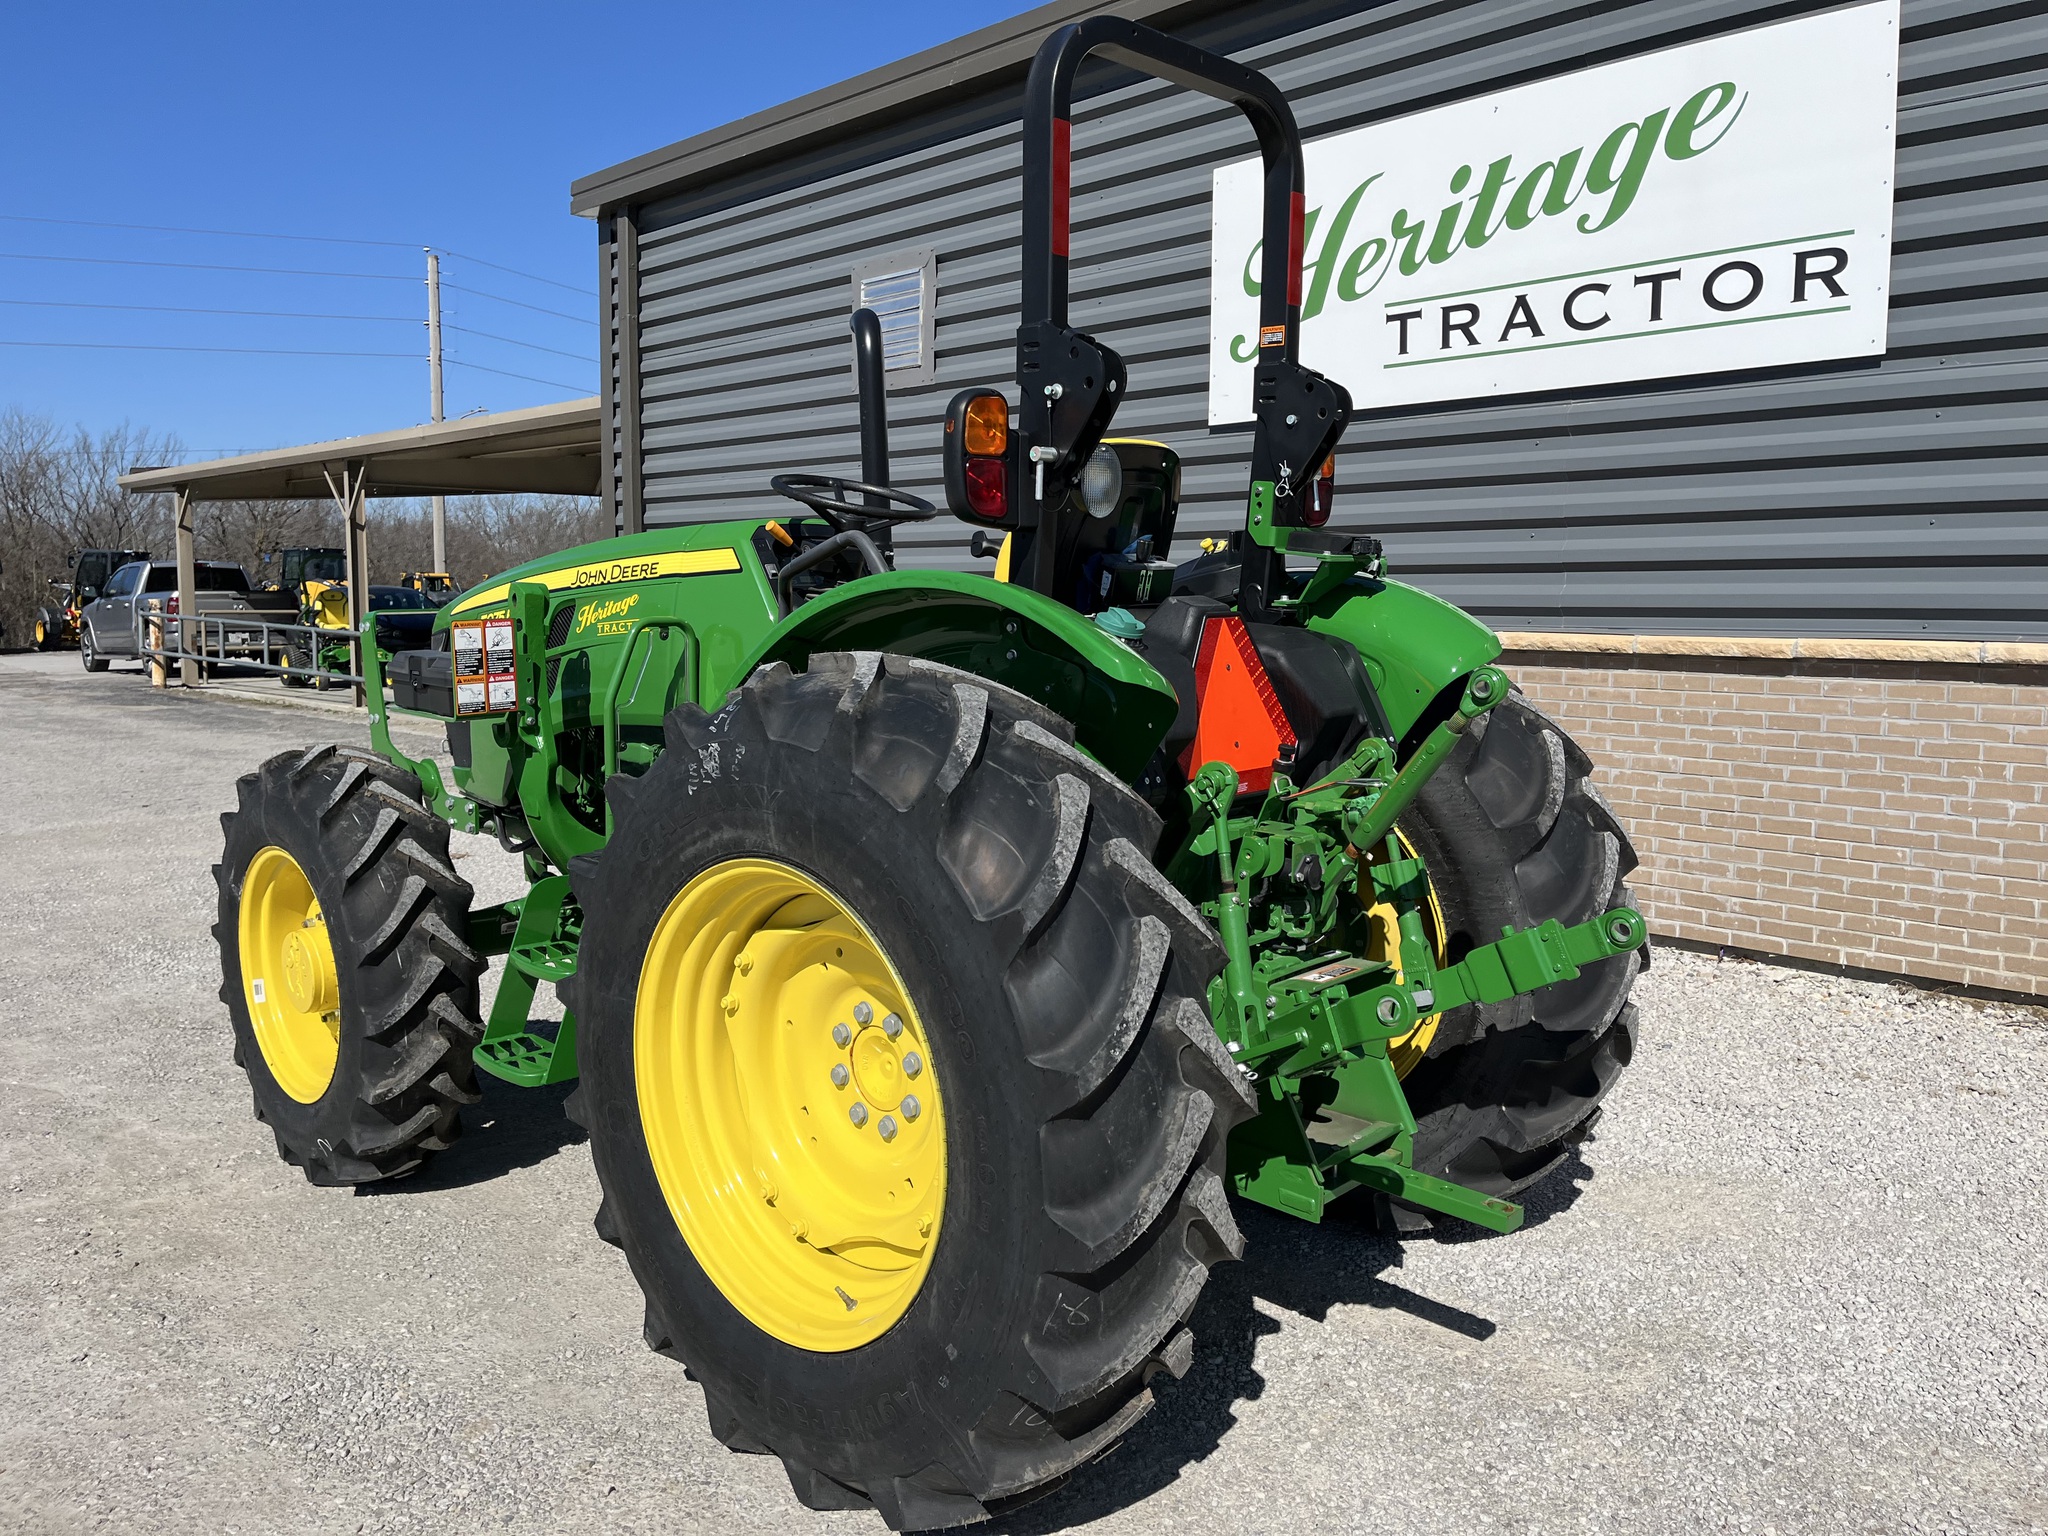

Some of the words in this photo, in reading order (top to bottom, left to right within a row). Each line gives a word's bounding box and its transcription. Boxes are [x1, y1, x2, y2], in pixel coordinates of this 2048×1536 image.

[1230, 82, 1749, 362] Heritage
[1385, 247, 1849, 355] TRACTOR
[571, 568, 607, 586] JOHN
[611, 562, 659, 580] DEERE
[576, 594, 639, 634] Heritage
[597, 622, 633, 634] TRACT
